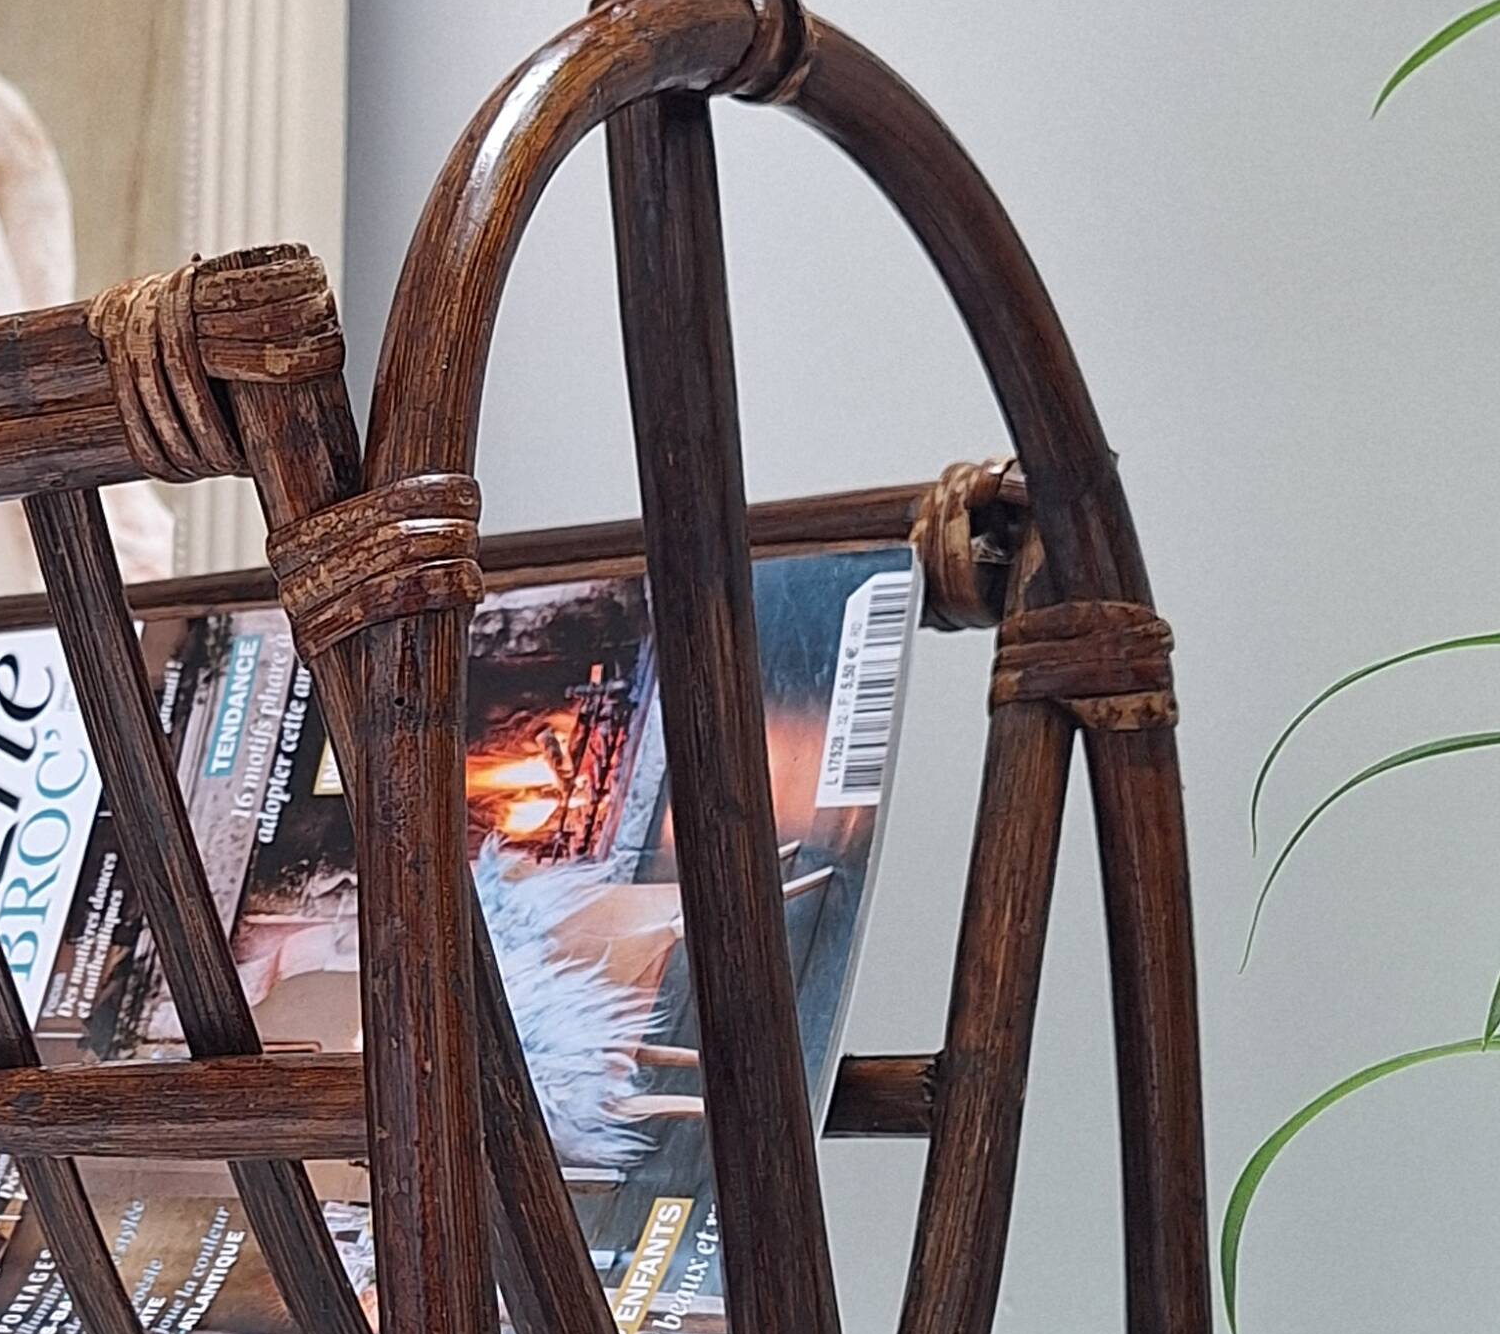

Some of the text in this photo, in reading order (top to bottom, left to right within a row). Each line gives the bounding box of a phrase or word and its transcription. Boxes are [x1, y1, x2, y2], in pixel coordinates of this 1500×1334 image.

[211, 639, 257, 771] TENDANCE
[257, 656, 282, 714] phare
[231, 792, 254, 816] 16
[242, 718, 275, 788] motifs
[255, 757, 291, 842] adopter
[280, 700, 306, 751] cette
[56, 852, 117, 1017] Des matières douces
[73, 888, 123, 1018] et authentiques
[190, 1205, 230, 1276] couleur
[616, 1202, 681, 1321] ENFANTS
[653, 1256, 707, 1331] beaux
[696, 1228, 719, 1255] et
